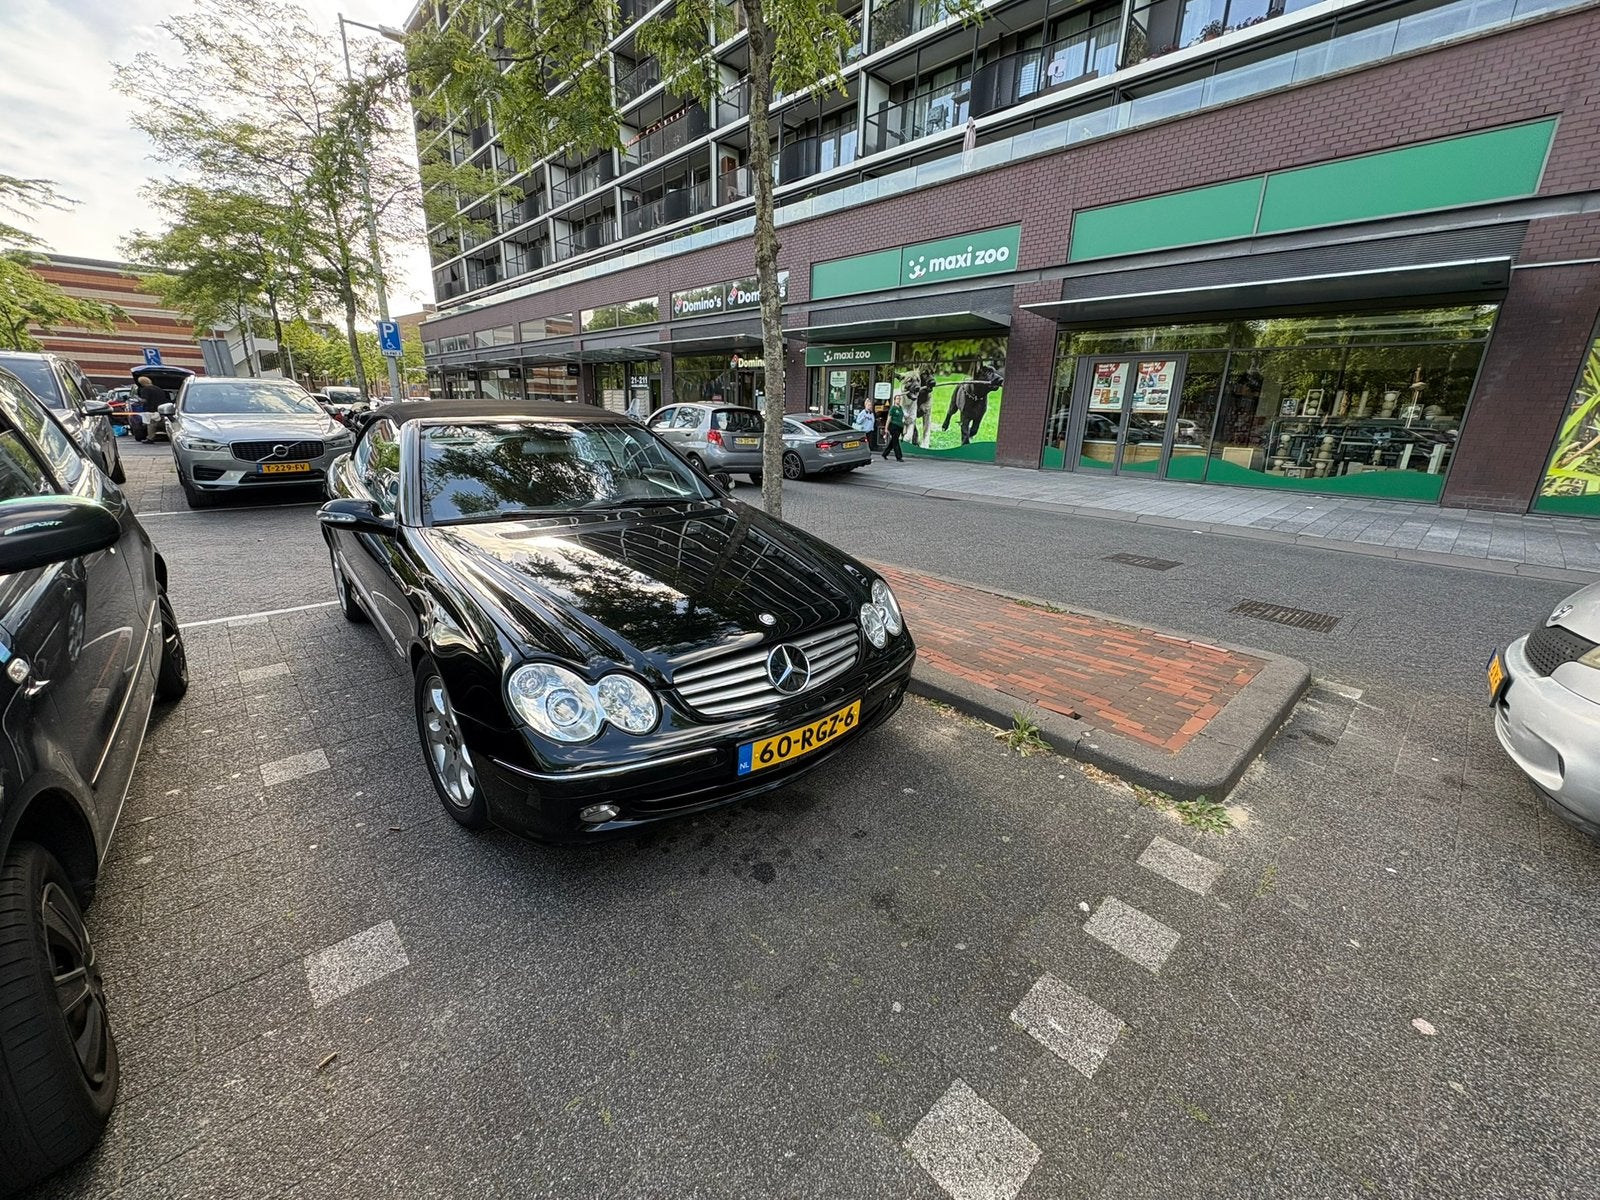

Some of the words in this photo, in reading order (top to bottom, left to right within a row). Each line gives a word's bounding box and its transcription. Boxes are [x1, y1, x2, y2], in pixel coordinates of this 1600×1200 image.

[929, 246, 972, 272] maxi
[975, 247, 1010, 265] zoo
[737, 284, 786, 304] Dom's
[682, 295, 722, 313] Domino's
[382, 322, 395, 339] P
[146, 349, 156, 360] P
[833, 348, 854, 360] maxi
[855, 350, 871, 359] zoo
[738, 356, 766, 368] Domin
[631, 376, 648, 384] 21-211
[266, 464, 306, 472] T-229-FV
[739, 762, 750, 770] NL
[759, 706, 855, 764] 60-RGZ-6
